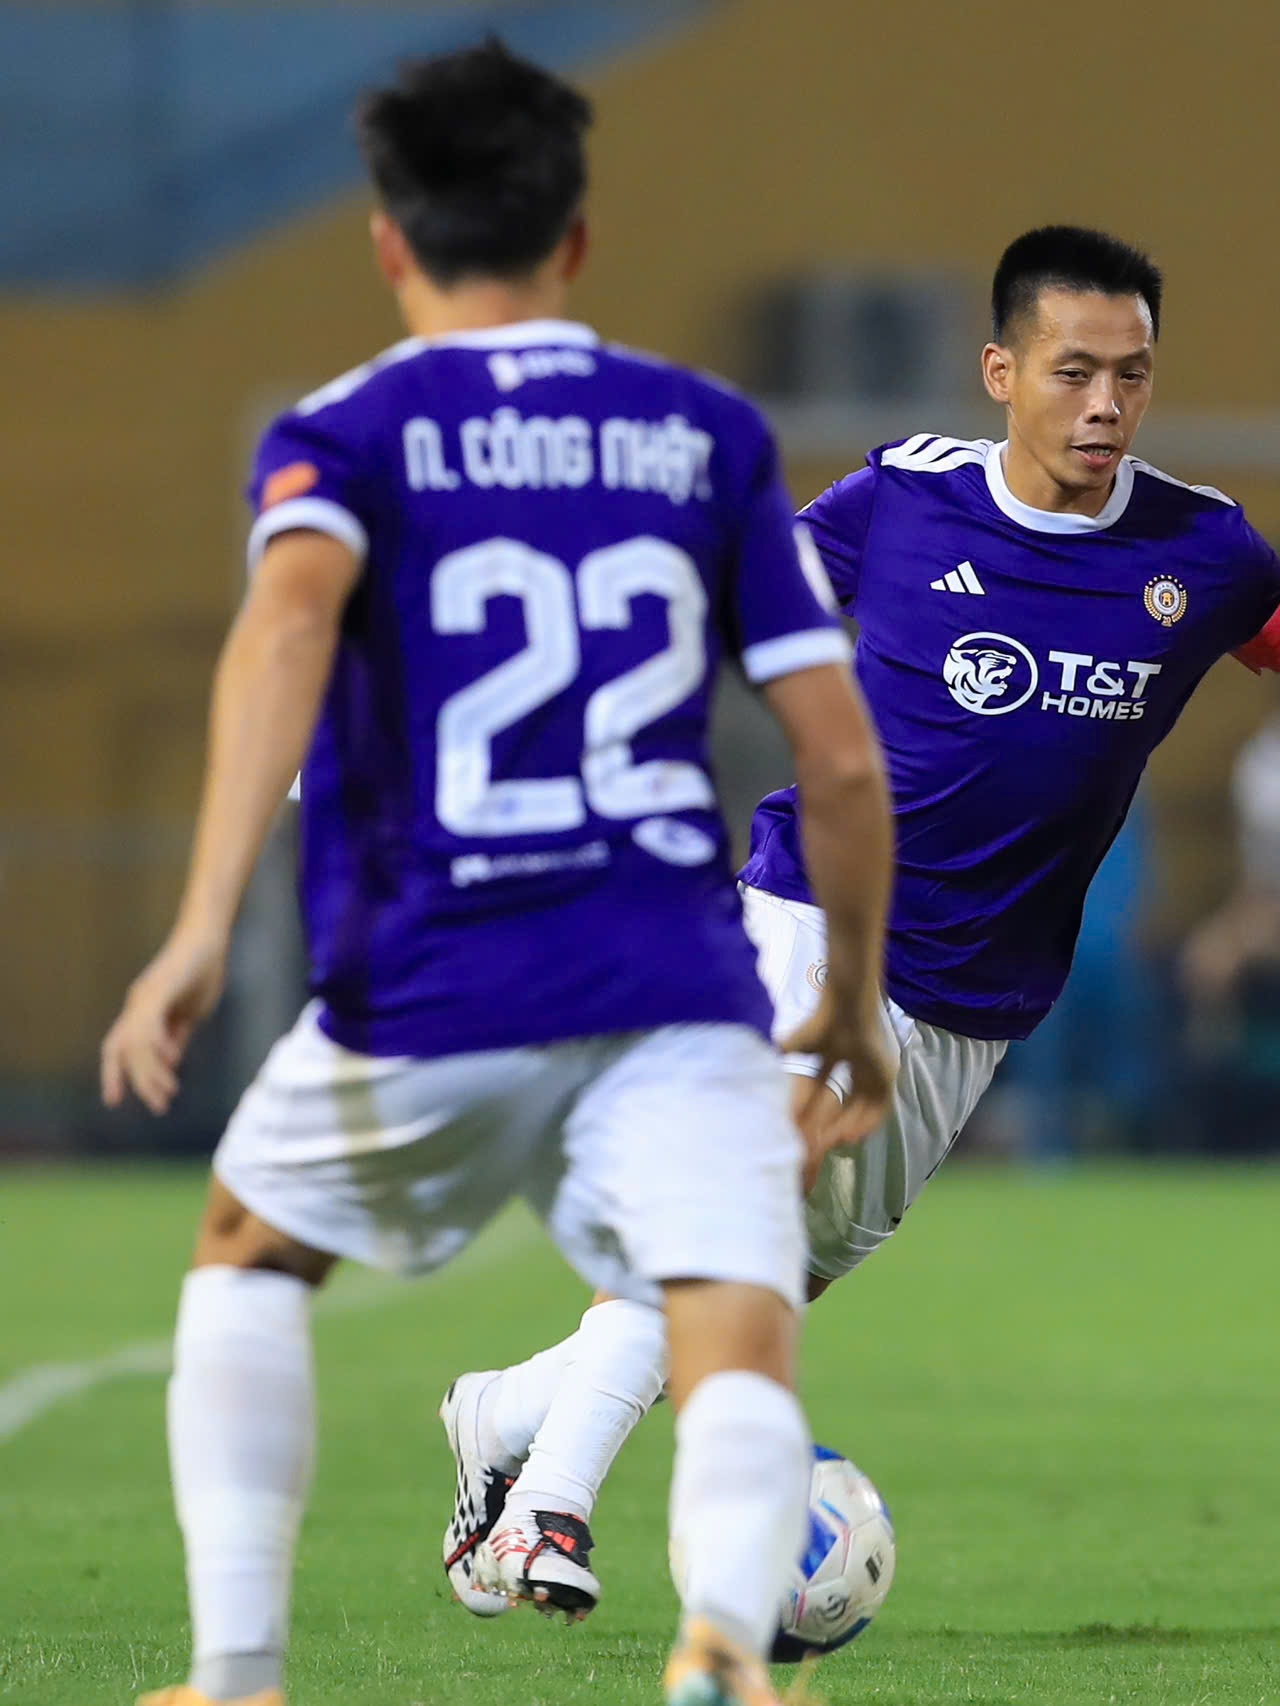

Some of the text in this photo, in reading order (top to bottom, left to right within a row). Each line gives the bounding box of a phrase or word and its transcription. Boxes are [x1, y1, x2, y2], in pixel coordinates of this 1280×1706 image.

[458, 404, 595, 490] CÔNG
[430, 535, 716, 838] 22
[1041, 691, 1147, 720] HOMES
[1048, 650, 1162, 699] T&T
